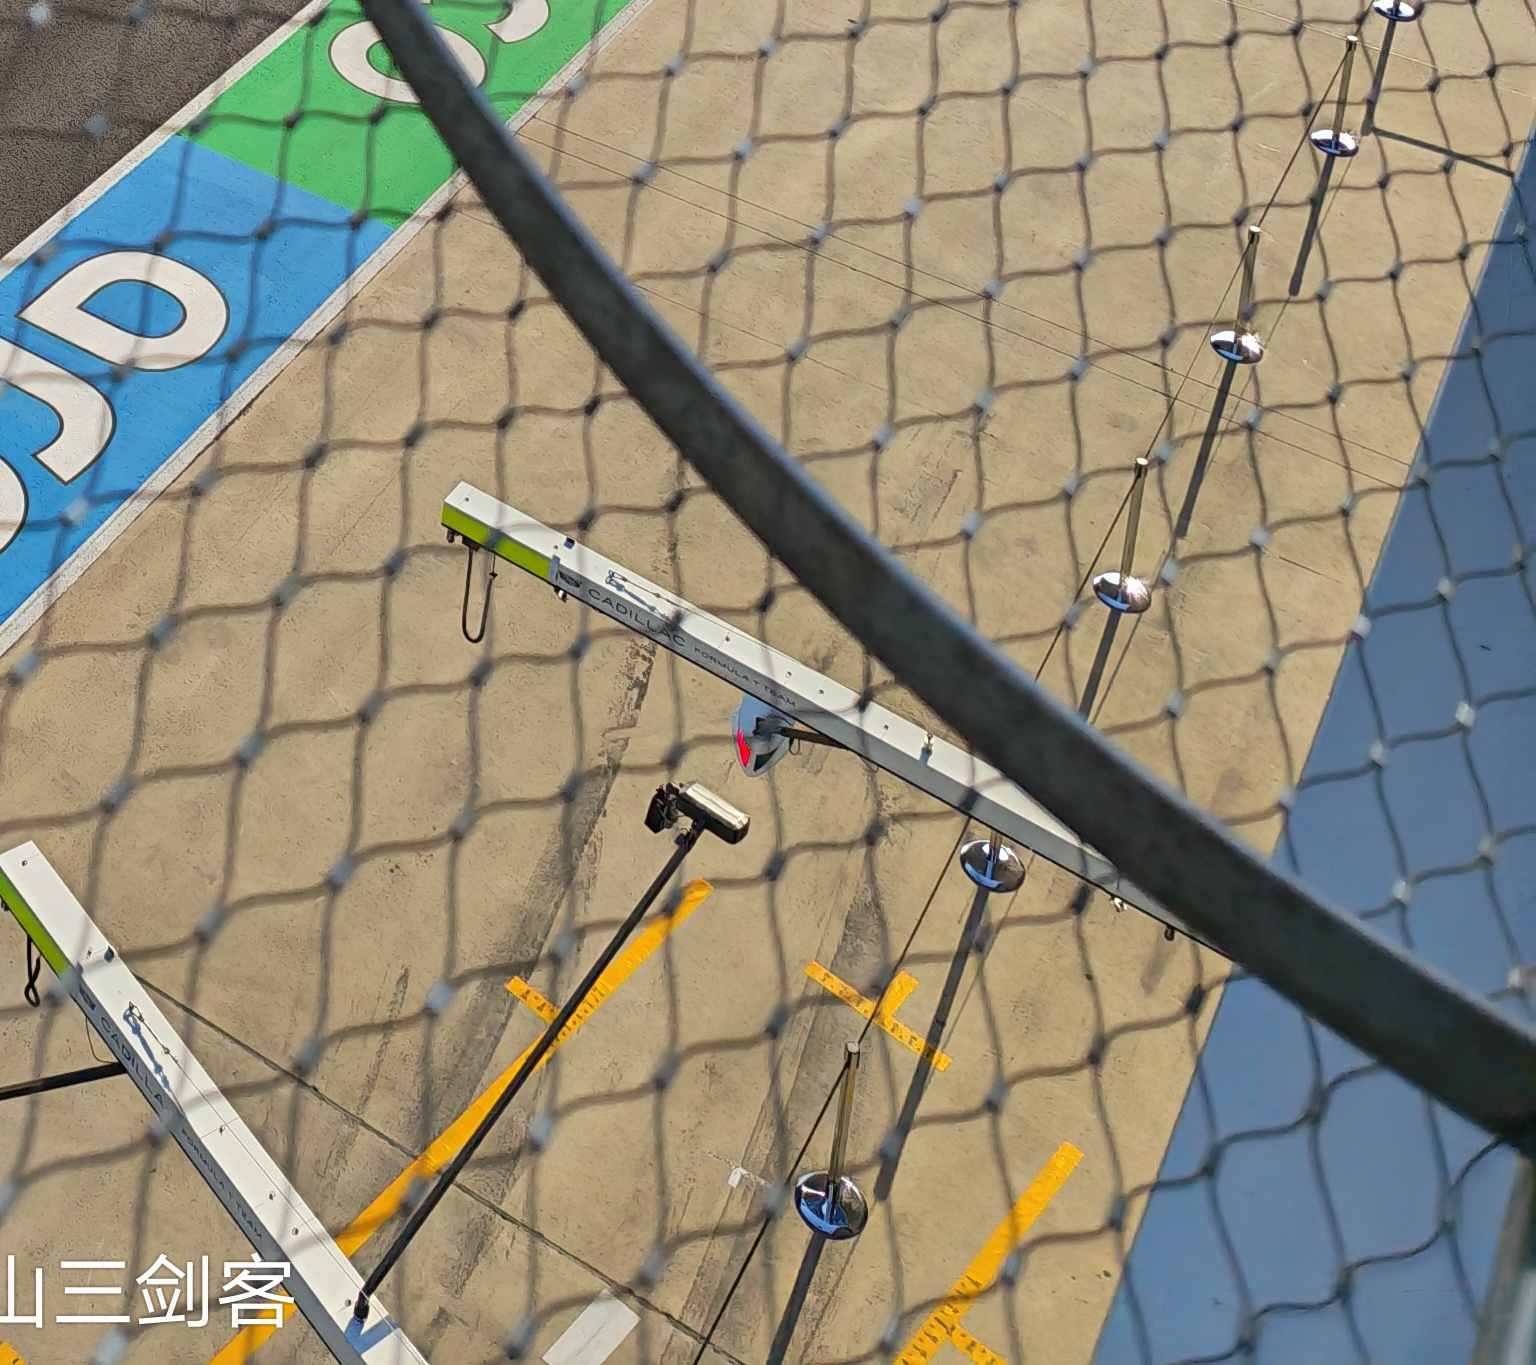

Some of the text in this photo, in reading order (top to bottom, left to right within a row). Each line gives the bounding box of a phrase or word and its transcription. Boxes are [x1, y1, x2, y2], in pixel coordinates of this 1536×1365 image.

[588, 587, 686, 648] CADILLAC
[693, 646, 751, 684] FORMULA
[761, 682, 797, 709] TEAM
[100, 1016, 176, 1125] CADILLA
[180, 1127, 225, 1191] FORMULA
[235, 1201, 263, 1240] TEAM
